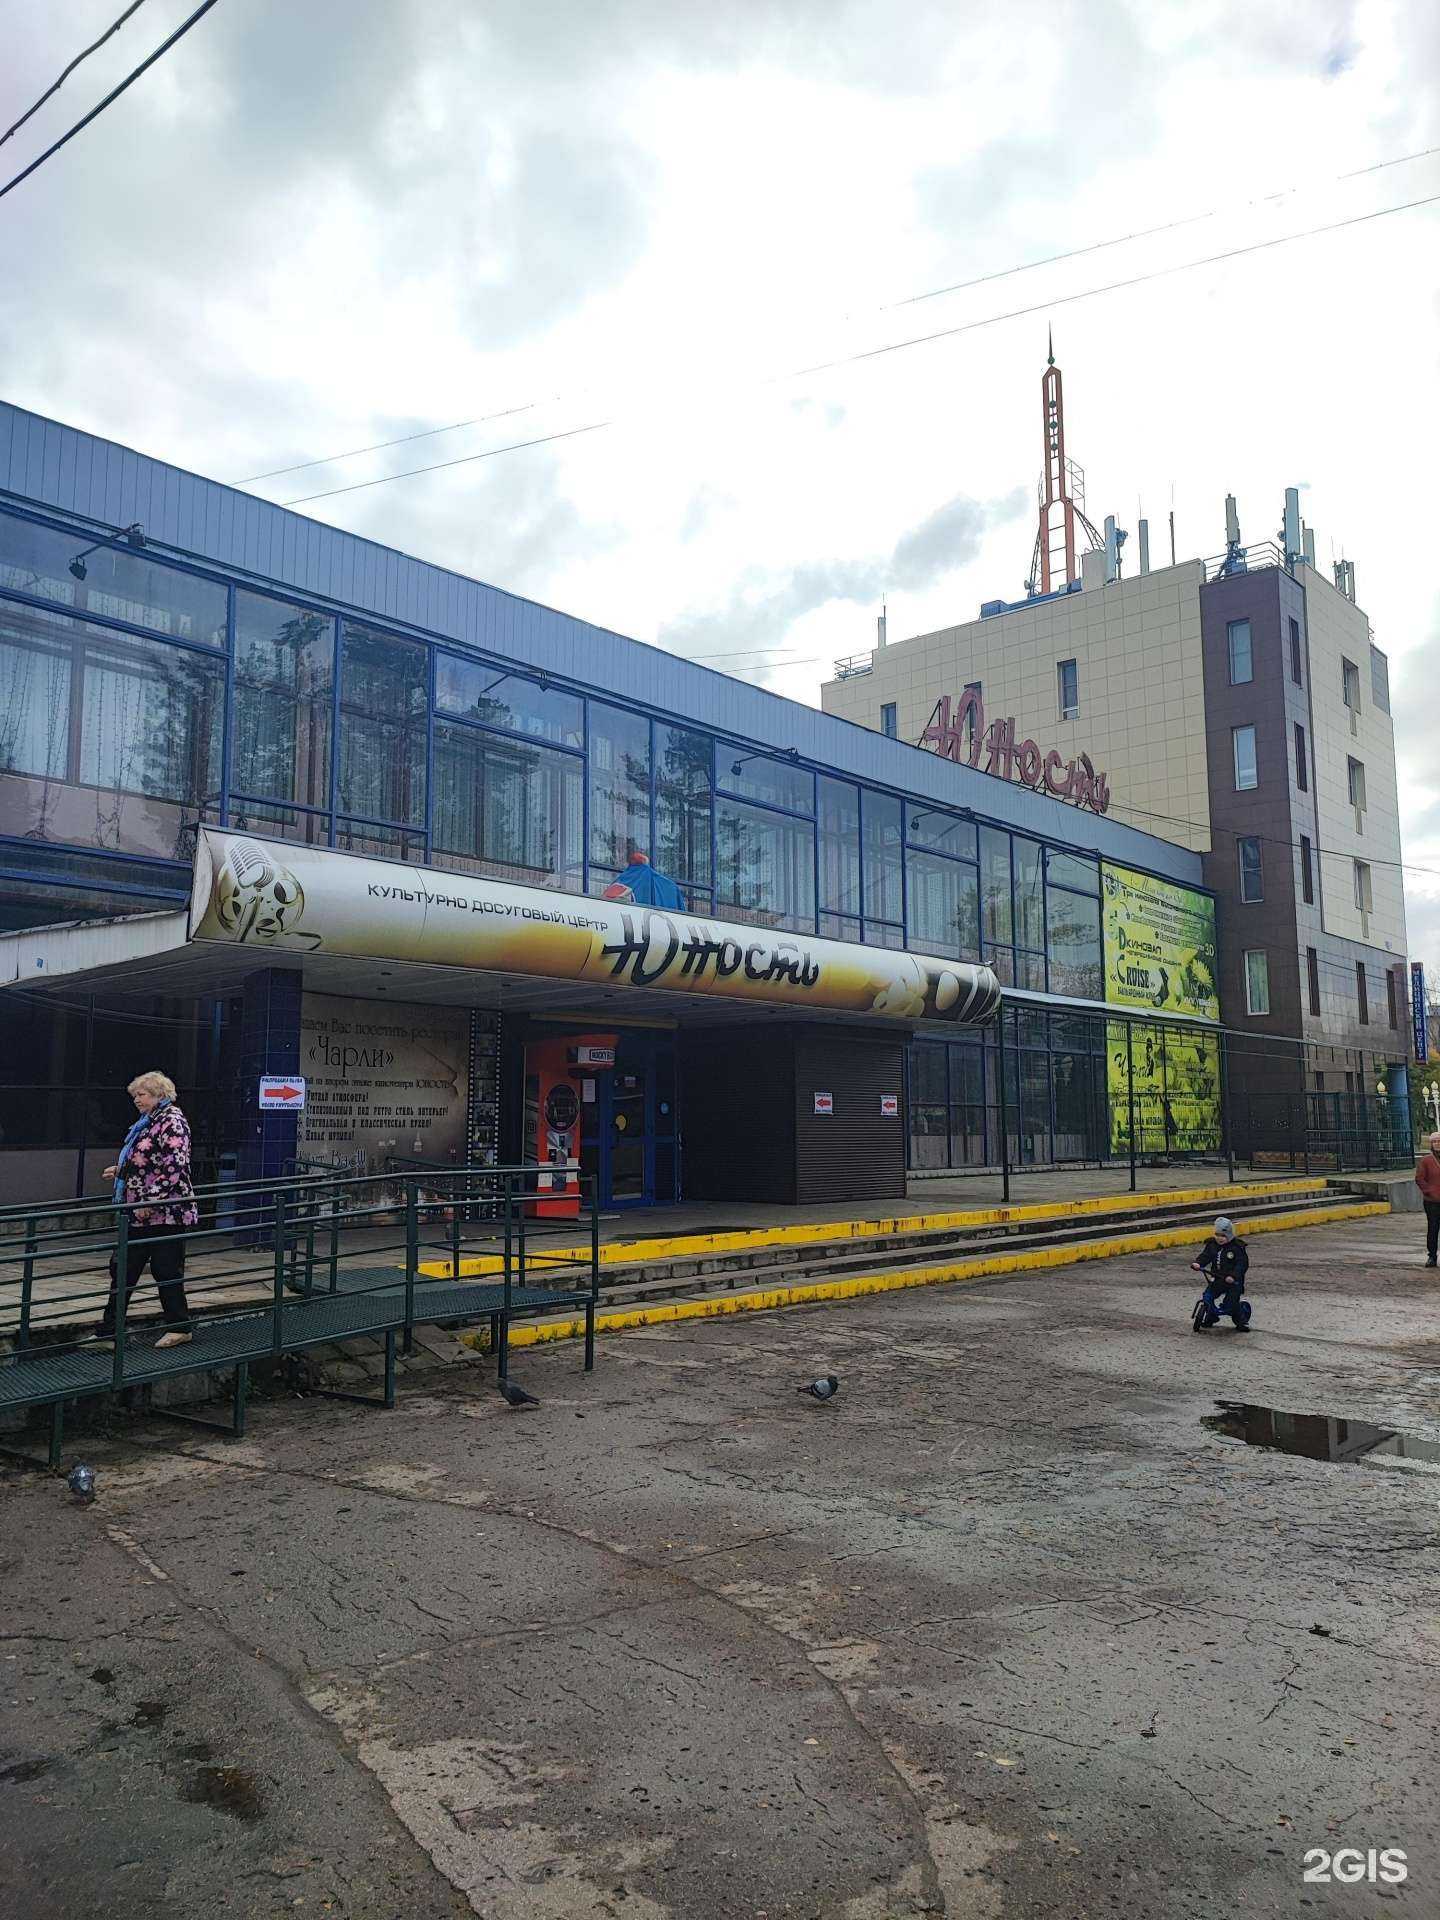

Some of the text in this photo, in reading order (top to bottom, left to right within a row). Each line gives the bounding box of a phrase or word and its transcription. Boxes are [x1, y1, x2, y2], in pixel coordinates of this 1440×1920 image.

[367, 883, 609, 931] КУЛЬТУРНО ДОСУГОВЫЙ ЦЕНТР
[309, 1035, 394, 1077] «Чарли»
